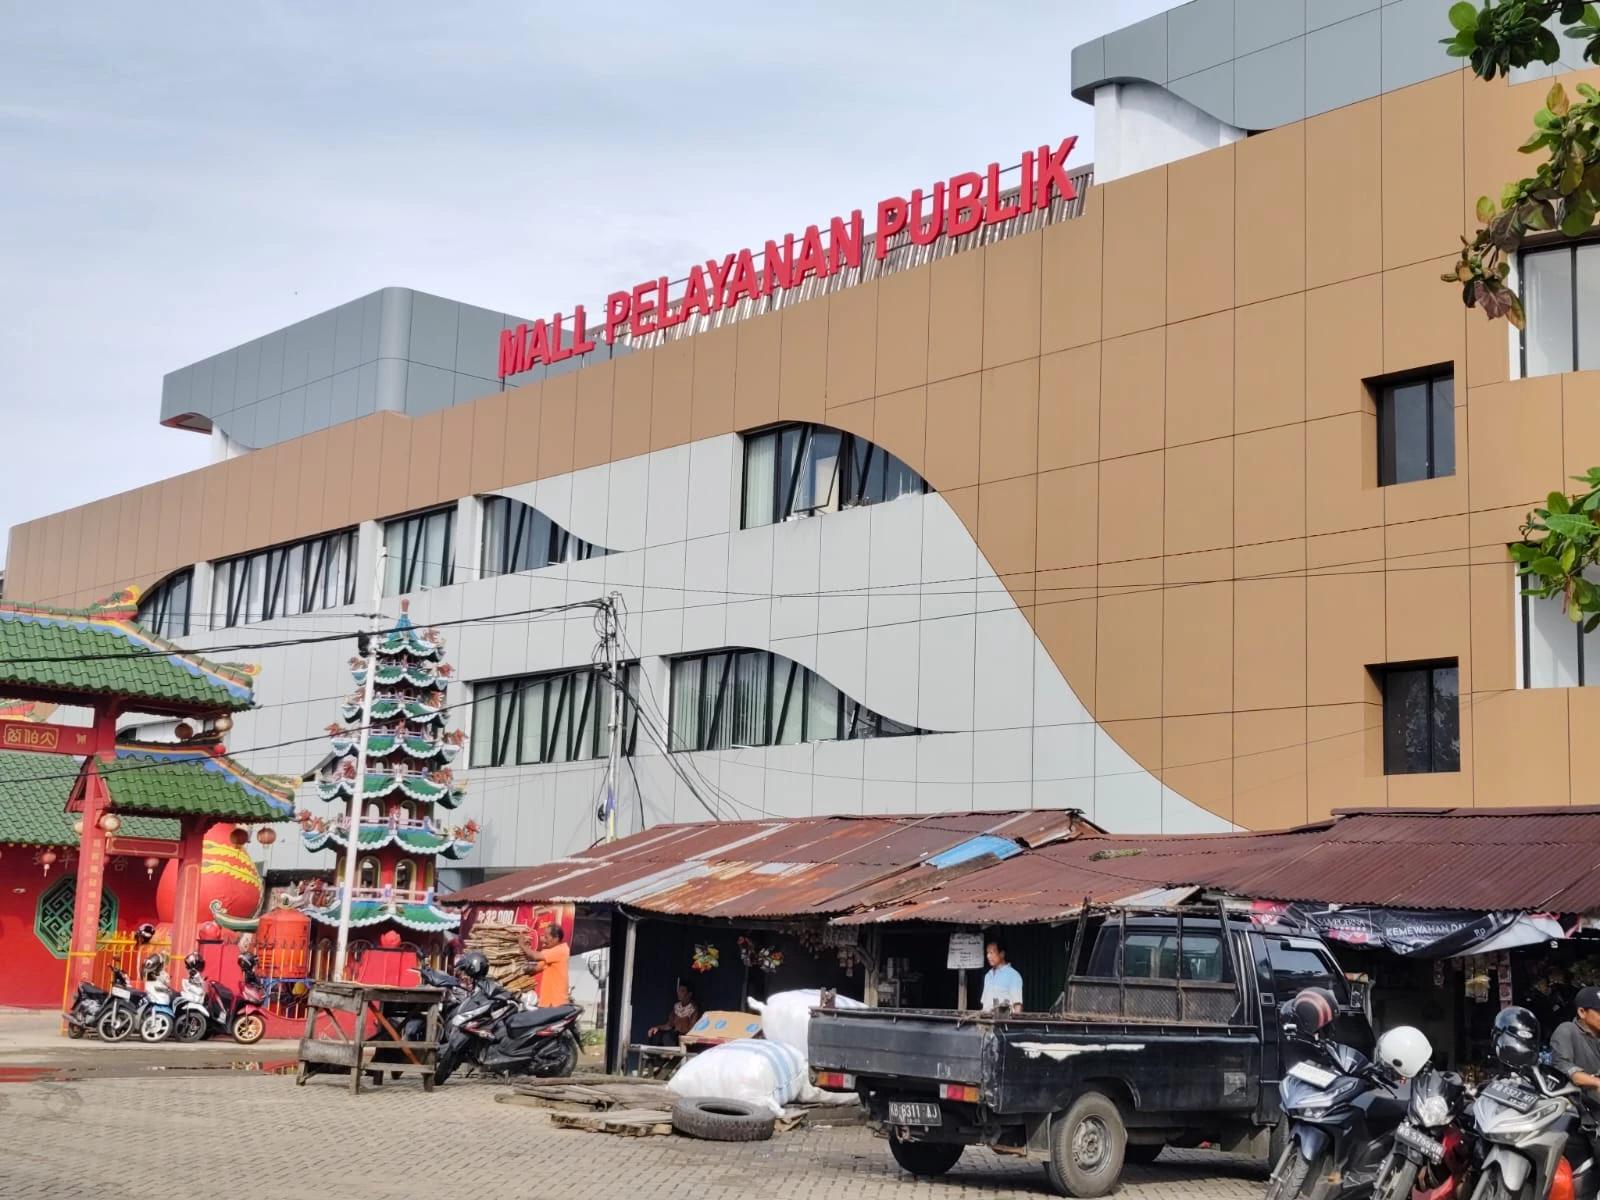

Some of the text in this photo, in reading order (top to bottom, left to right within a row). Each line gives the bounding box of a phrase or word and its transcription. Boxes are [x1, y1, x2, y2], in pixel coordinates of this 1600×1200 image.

[498, 135, 1078, 378] MALL PELAYANAN PUBLIK
[1386, 924, 1449, 936] KEMEWAHAN
